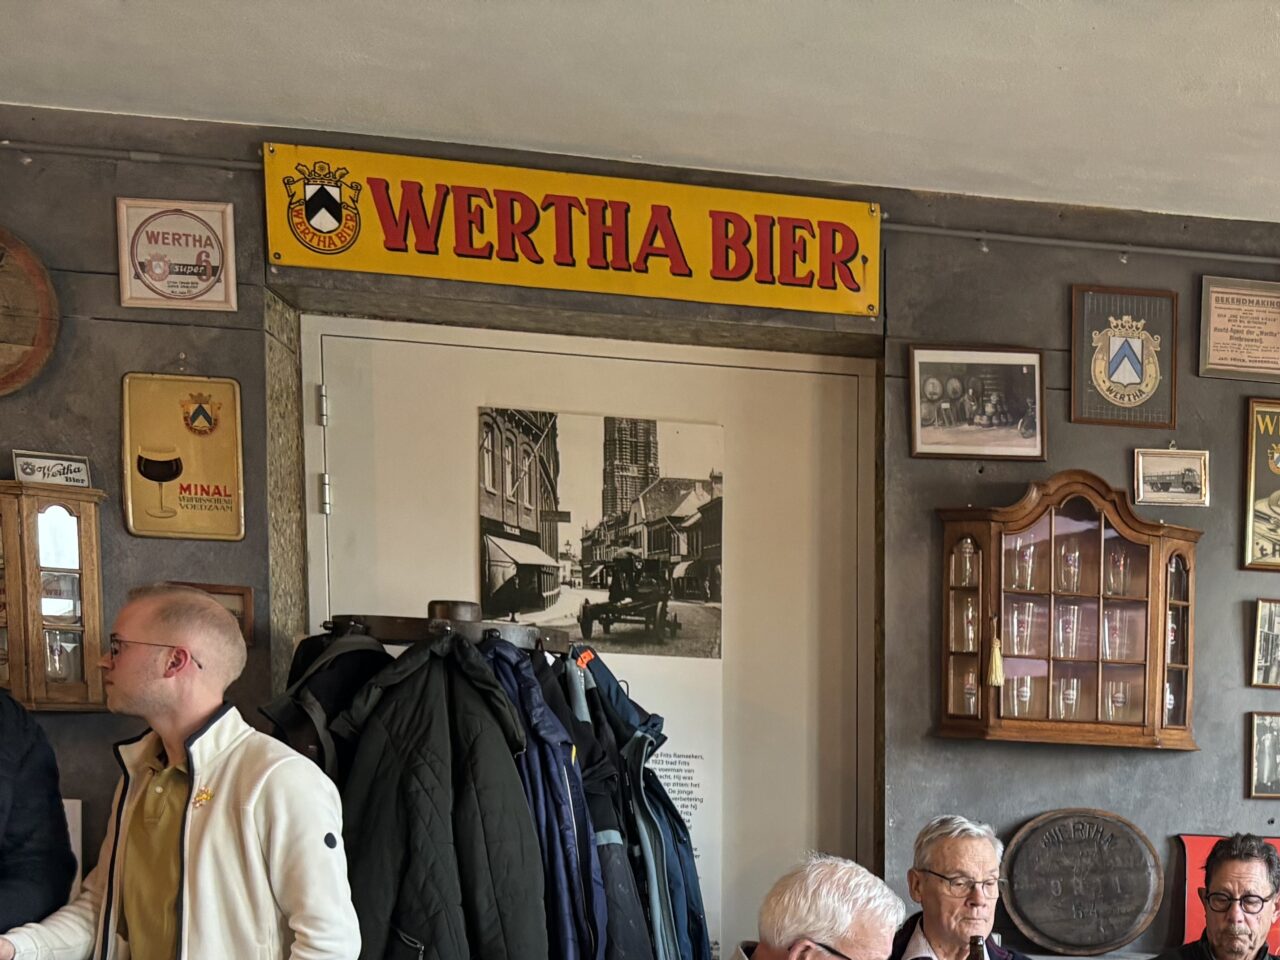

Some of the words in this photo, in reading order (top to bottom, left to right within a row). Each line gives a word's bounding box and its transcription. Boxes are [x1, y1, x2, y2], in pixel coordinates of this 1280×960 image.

[292, 208, 338, 248] WERTHA
[336, 213, 356, 244] BIER
[366, 177, 692, 278] WERTHA
[708, 210, 861, 292] BIER
[145, 230, 214, 249] WERTHA
[173, 264, 205, 275] super
[1106, 386, 1146, 402] WERTHA
[179, 483, 232, 497] MINAL
[179, 503, 233, 512] VOEDZAAM
